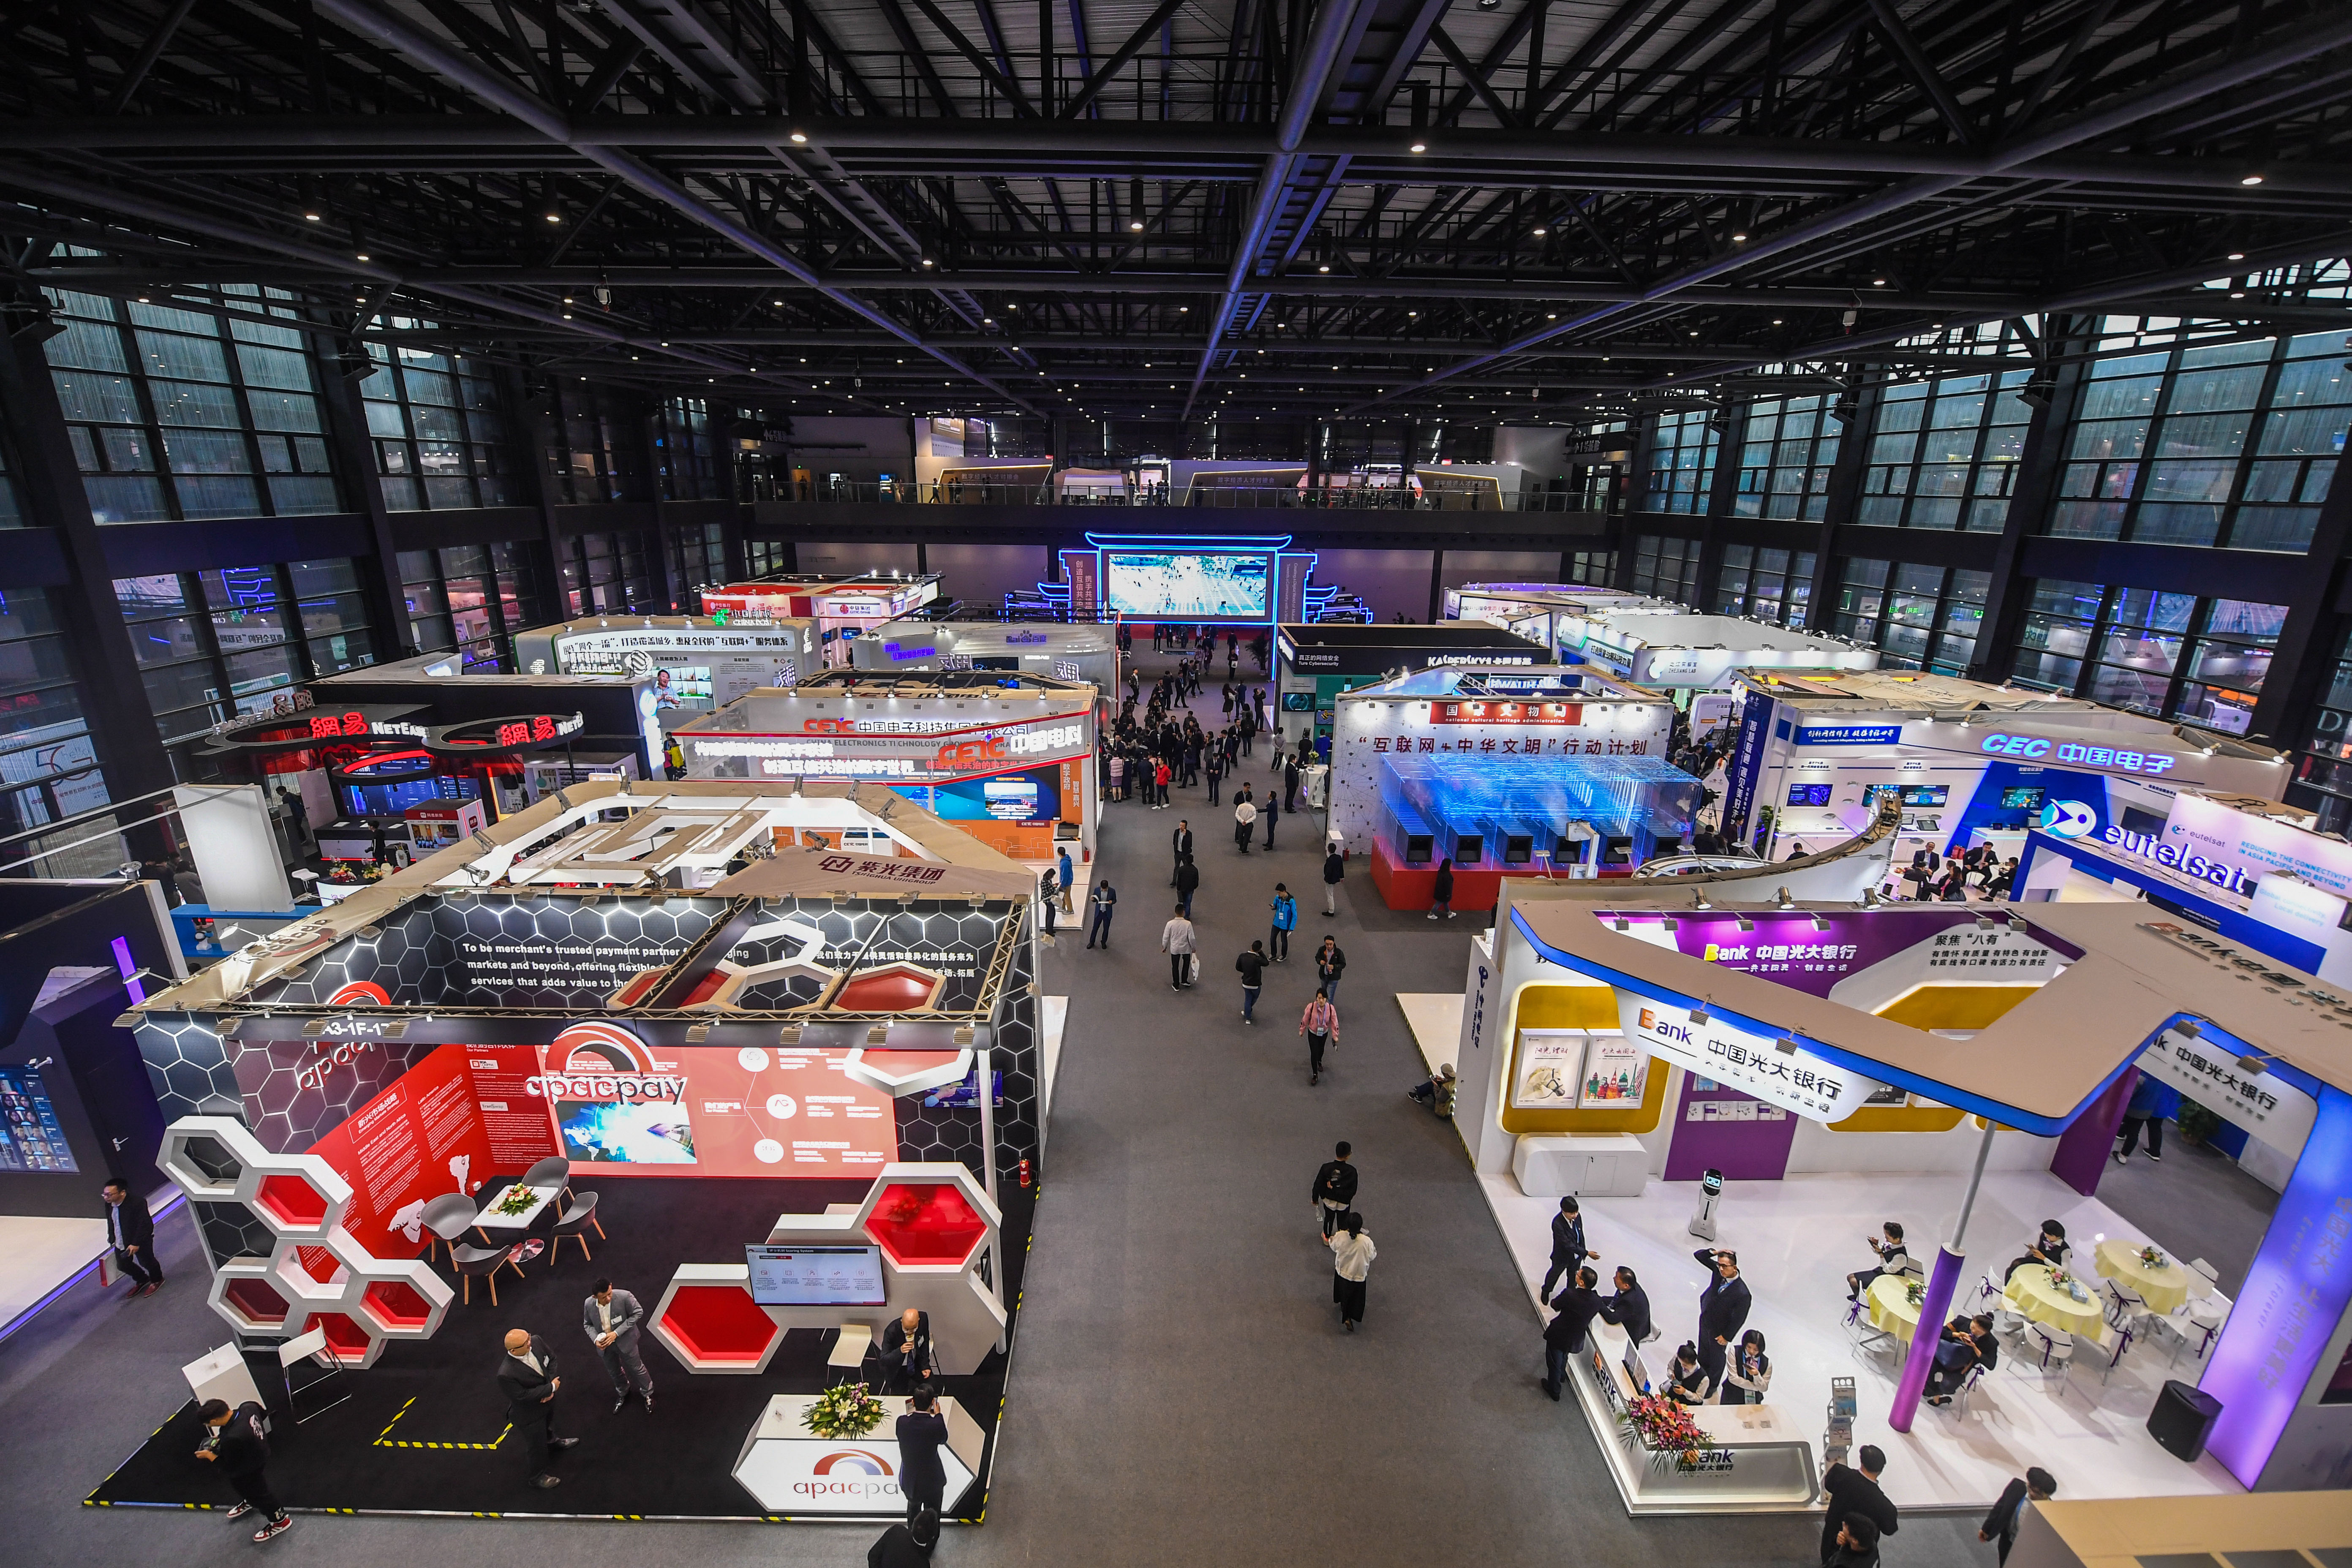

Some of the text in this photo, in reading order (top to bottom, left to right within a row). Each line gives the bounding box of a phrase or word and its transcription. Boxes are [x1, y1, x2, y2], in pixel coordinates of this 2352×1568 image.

[1010, 724, 1083, 754] 中国电科
[1982, 734, 2175, 774] CEC 中国电子
[2189, 829, 2225, 848] eutelsat
[2103, 824, 2249, 894] eutelsat
[2240, 841, 2352, 882] REDUCING THE CONNECTIVITY
[852, 871, 936, 885] TSINGHUA UNIGROUP
[858, 860, 947, 881] 紫光集团
[2247, 851, 2264, 861] ASIA
[2265, 855, 2294, 873] PACIFIC
[2296, 868, 2311, 878] AND
[2313, 874, 2346, 890] BEYOND
[463, 943, 681, 958] To be merchant's trusted payment partner
[1935, 934, 1961, 946] 聚焦
[1704, 943, 1857, 961] Bank 中国光大银行
[1930, 959, 1957, 967] 有底线
[2019, 958, 2046, 966] 有责任
[1931, 949, 2049, 958] 有情怀 有质量 有特色 有创新
[467, 960, 508, 970] markets
[511, 961, 530, 970] and
[575, 963, 615, 973] offering
[471, 977, 611, 987] services that adds value to
[1638, 1007, 1843, 1101] Bank 中国光大银行
[2175, 1046, 2277, 1111] 中国光大银行
[417, 1086, 439, 1105] Latin America
[523, 1076, 688, 1105] apacpay
[357, 1092, 398, 1128] 新兴市场战略
[358, 1119, 374, 1134] Emerging
[374, 1109, 387, 1122] Markets
[357, 1113, 406, 1155] Middle East and North Africa
[793, 1481, 899, 1499] apacpa
